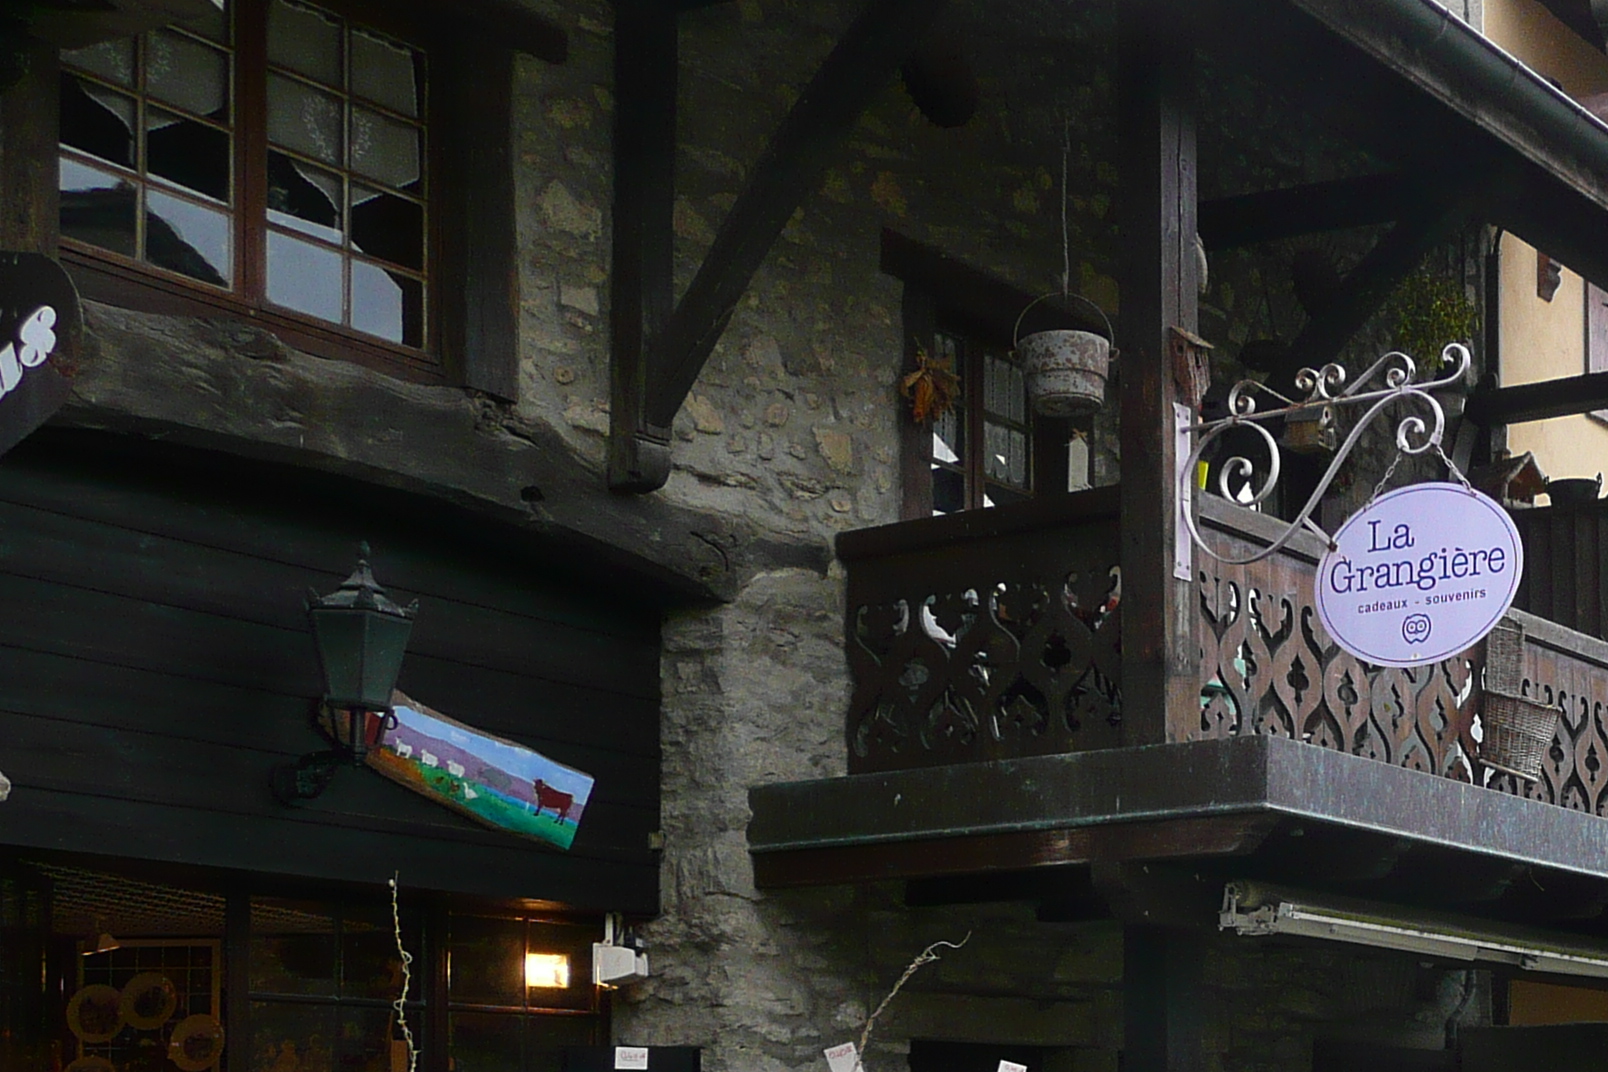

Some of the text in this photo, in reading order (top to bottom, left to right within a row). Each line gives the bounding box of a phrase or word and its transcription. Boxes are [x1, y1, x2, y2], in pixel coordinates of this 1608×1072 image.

[1367, 519, 1415, 553] La
[1330, 547, 1505, 594] Grangière
[1357, 598, 1408, 614] cadeaux
[1425, 587, 1487, 606] souvenirs
